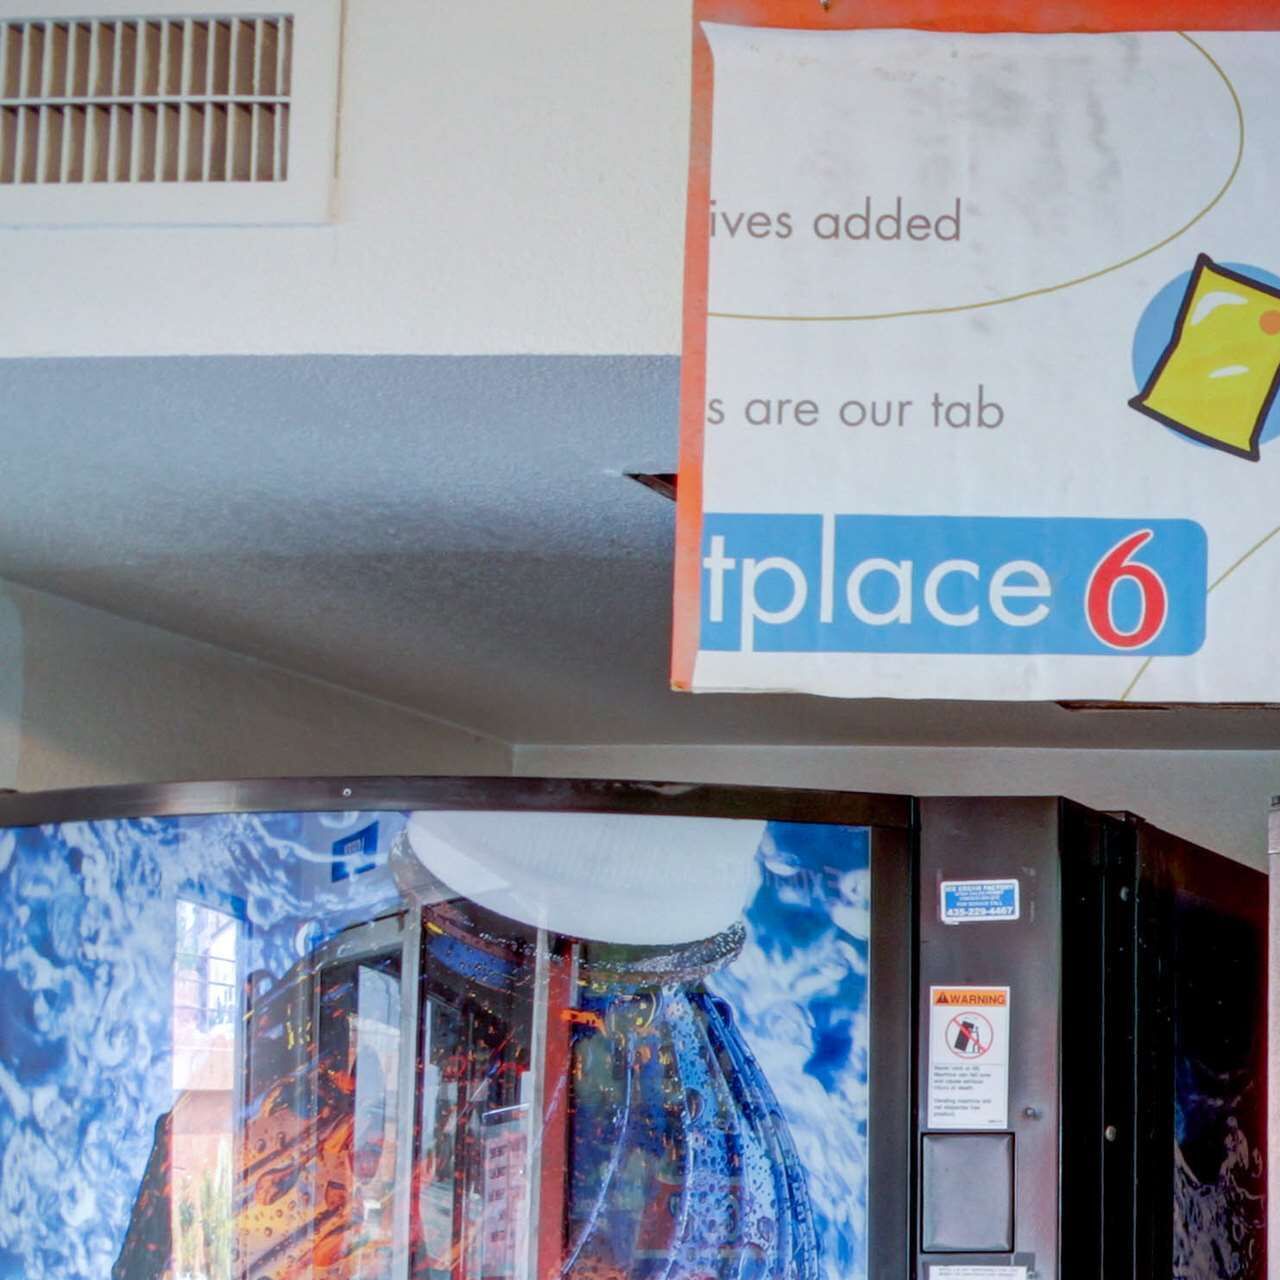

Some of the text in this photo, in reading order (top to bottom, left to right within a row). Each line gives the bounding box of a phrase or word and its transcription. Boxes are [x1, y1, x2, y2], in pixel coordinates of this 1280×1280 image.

[708, 197, 962, 243] ives added
[707, 385, 1006, 430] s are our tab
[702, 513, 1169, 653] tplace 6
[950, 994, 1006, 1006] WARNING
